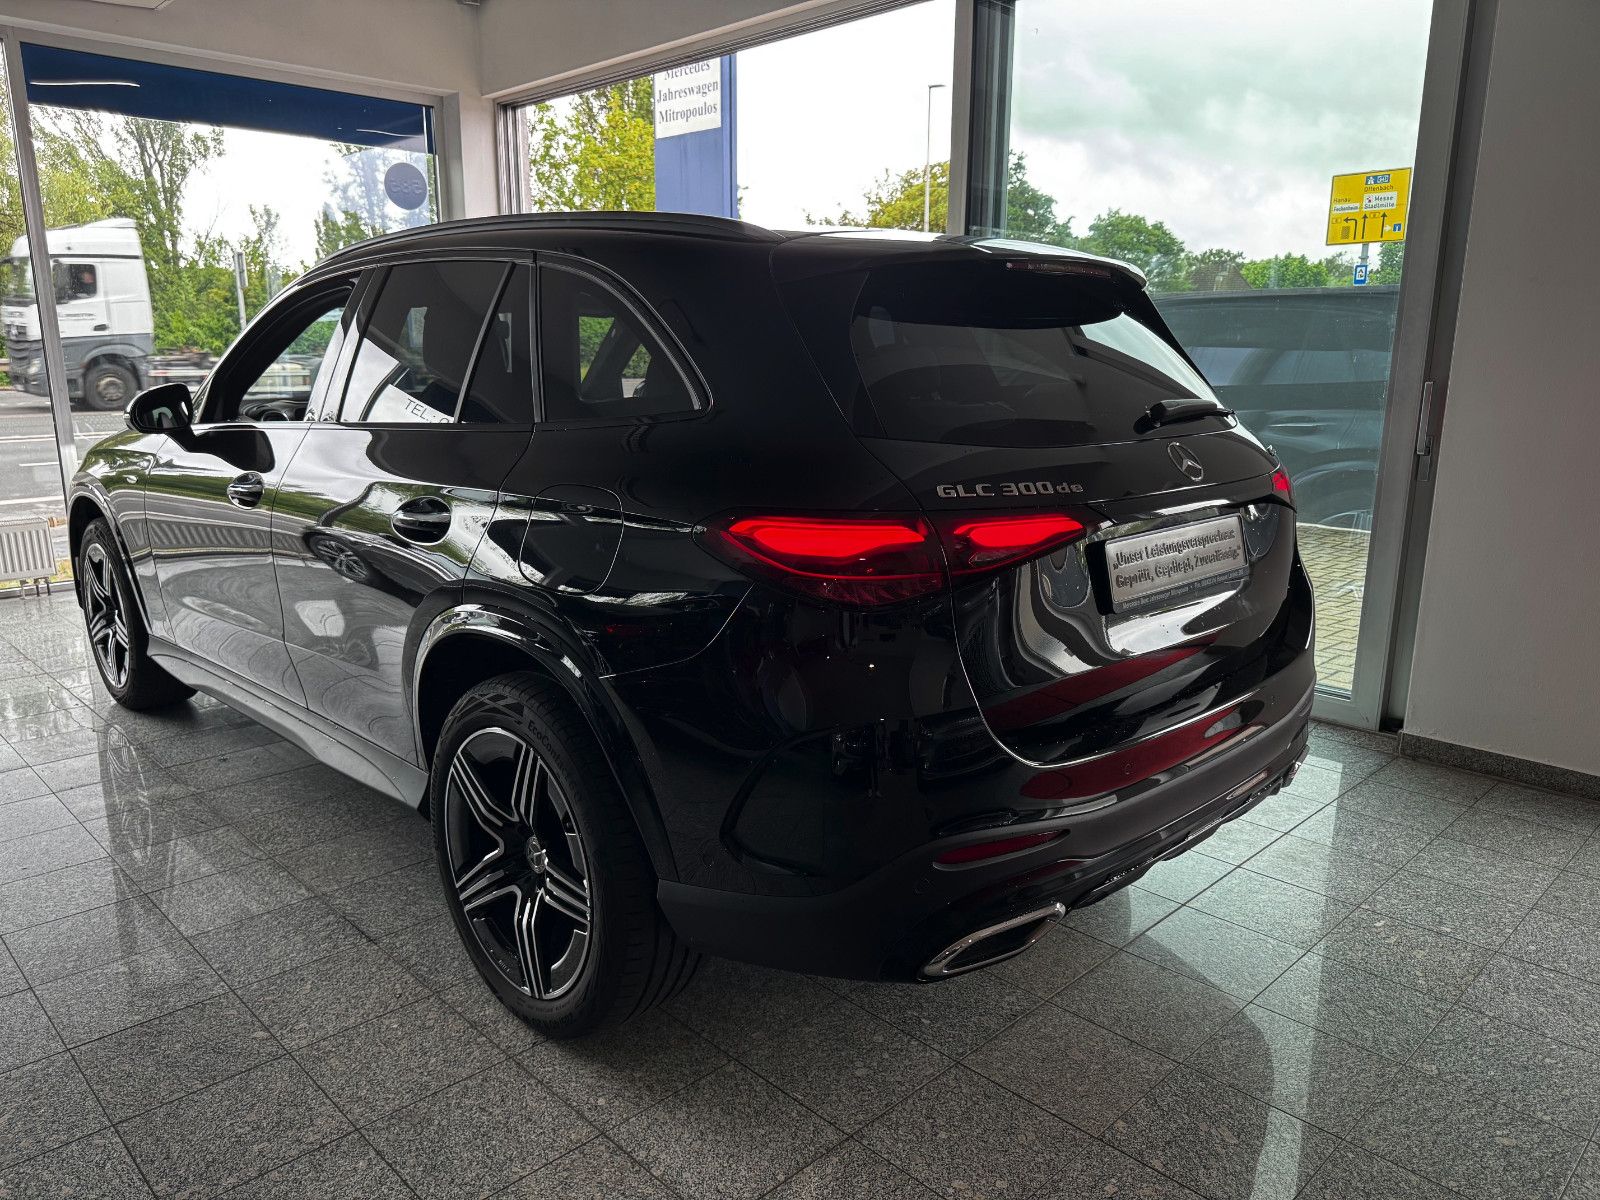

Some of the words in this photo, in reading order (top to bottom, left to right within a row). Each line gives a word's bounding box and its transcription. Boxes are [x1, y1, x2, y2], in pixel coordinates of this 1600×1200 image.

[657, 81, 719, 103] Jahreswagen
[658, 101, 718, 124] Mitropoulos
[1364, 202, 1395, 210] Stadtmitte
[936, 483, 995, 498] GLC
